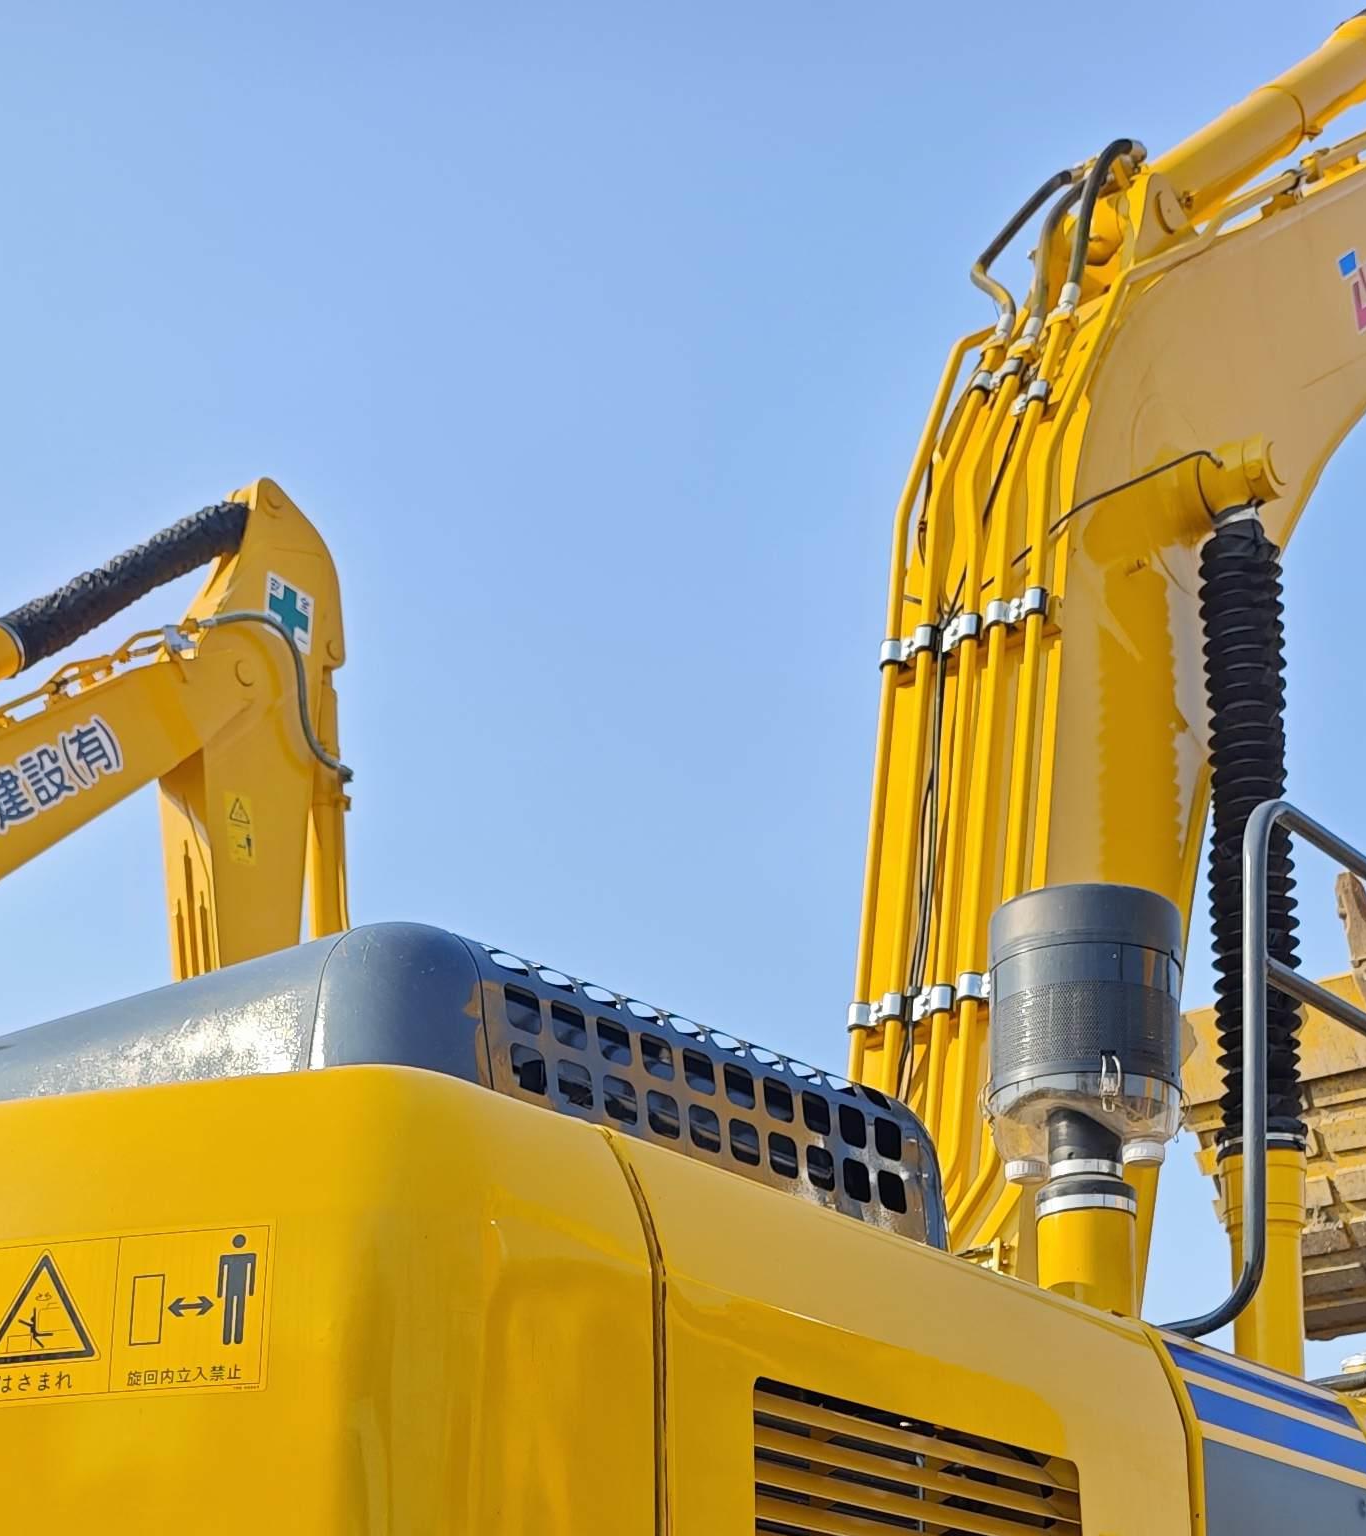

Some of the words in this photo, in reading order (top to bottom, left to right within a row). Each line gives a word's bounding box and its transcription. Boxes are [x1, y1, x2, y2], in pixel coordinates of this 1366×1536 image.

[127, 1364, 242, 1387] 旋回内立入禁止
